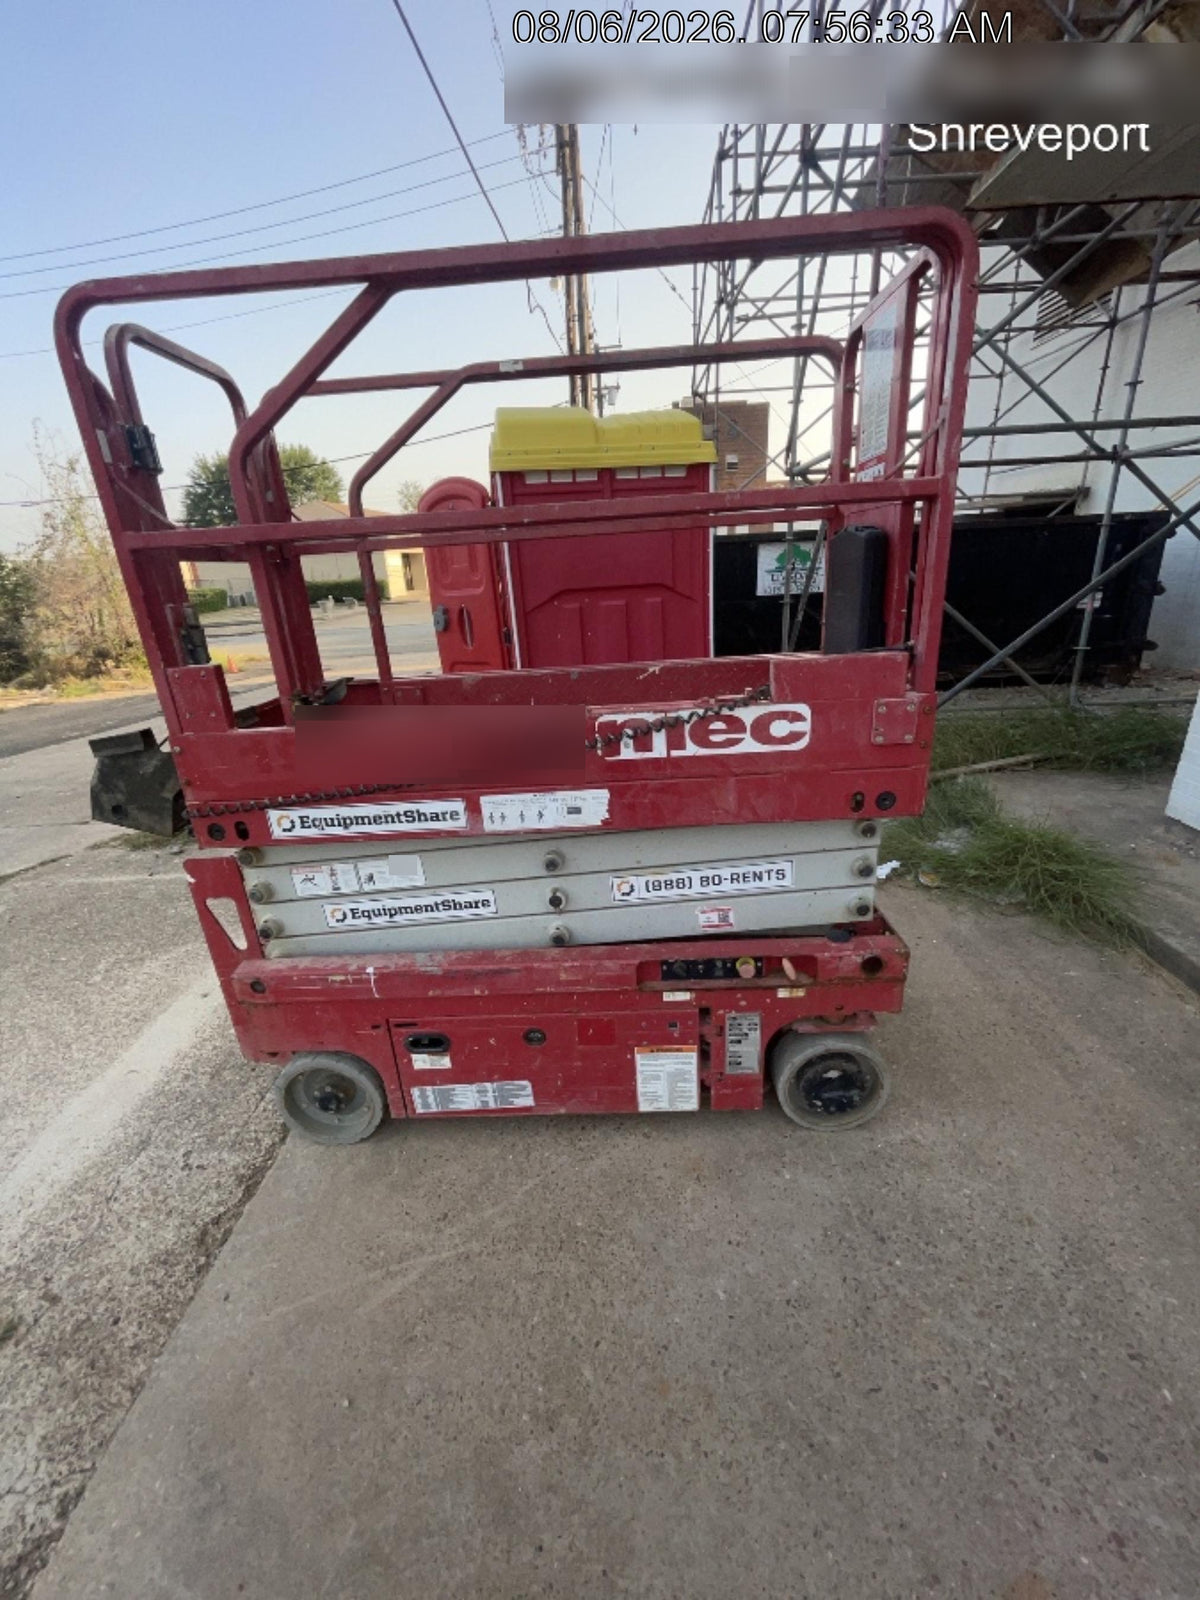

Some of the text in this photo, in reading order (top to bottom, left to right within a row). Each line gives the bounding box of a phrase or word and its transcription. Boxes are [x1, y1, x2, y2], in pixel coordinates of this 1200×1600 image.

[299, 809, 461, 831] EquipmentShare
[645, 868, 786, 893] (888) 80-RENTS
[351, 898, 492, 921] EquipmentShare
